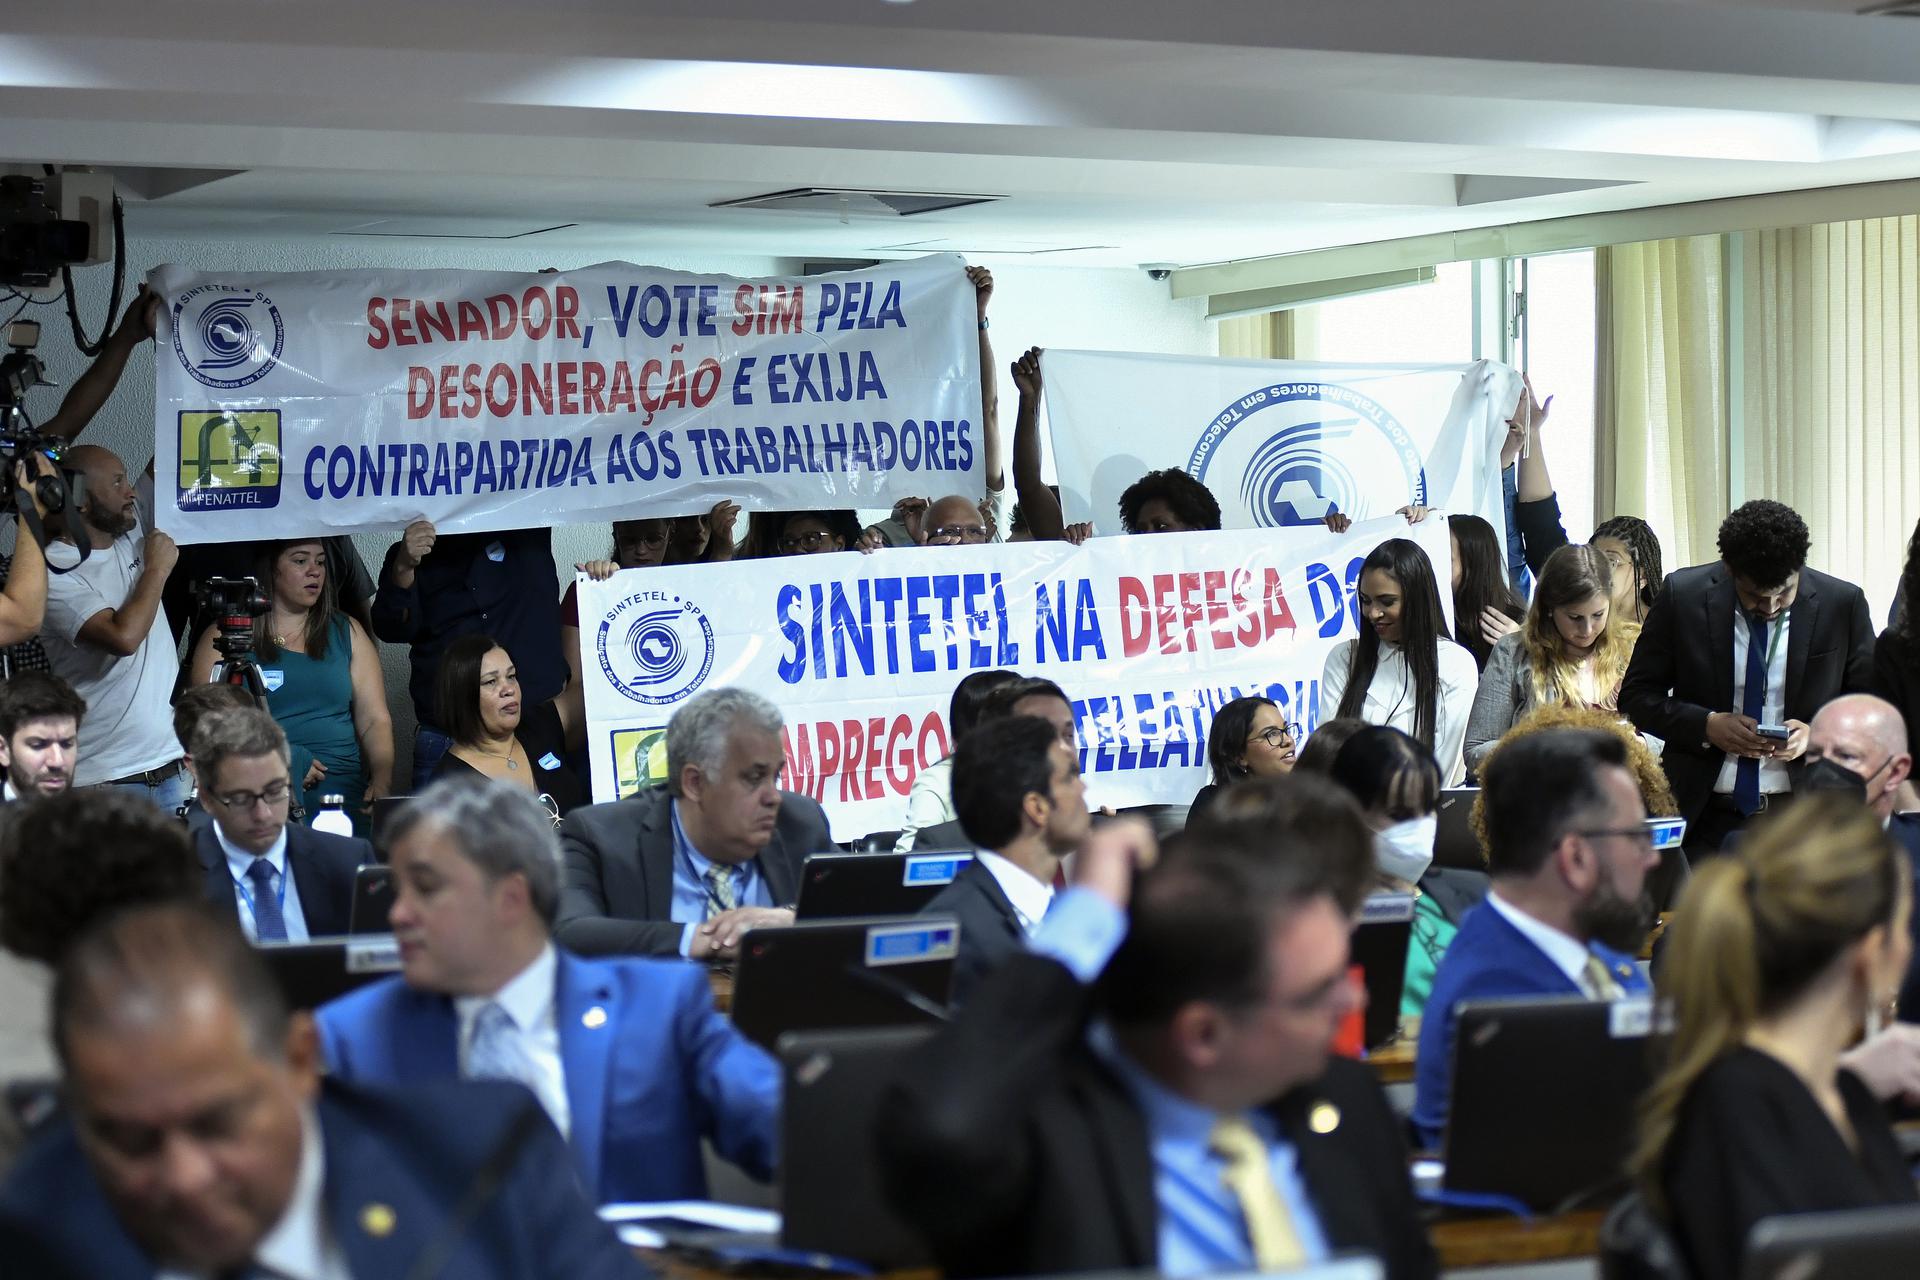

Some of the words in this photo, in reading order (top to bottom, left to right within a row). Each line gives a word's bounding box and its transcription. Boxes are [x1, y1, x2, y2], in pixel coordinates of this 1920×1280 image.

[180, 284, 239, 304] SINTETEL
[255, 291, 272, 306] SP
[367, 285, 594, 349] SENADOR,
[607, 284, 718, 338] VOTE
[732, 283, 803, 337] SIM
[817, 280, 907, 332] PELA
[177, 351, 188, 365] dos
[187, 364, 240, 388] Trabalhadores
[241, 376, 255, 386] em
[407, 343, 721, 426] DESONERAÇÃO
[733, 357, 757, 405] E
[767, 350, 887, 404] EXIJA
[1240, 391, 1267, 410] em
[304, 434, 596, 500] CONTRAPARTIDA
[607, 429, 682, 484] AOS
[687, 419, 973, 476] TRABALHADORES
[197, 491, 262, 506] FENATTEL
[606, 591, 668, 621] SINTETEL
[684, 600, 701, 615] SP
[777, 572, 1018, 684] SINTETEL
[1035, 578, 1107, 663] NA
[1118, 567, 1297, 658] DEFESA
[598, 630, 608, 669] Sindicato
[606, 670, 618, 685] dos
[616, 683, 674, 705] Trabalhadores
[674, 691, 688, 700] em
[782, 711, 951, 804] MPREGO
